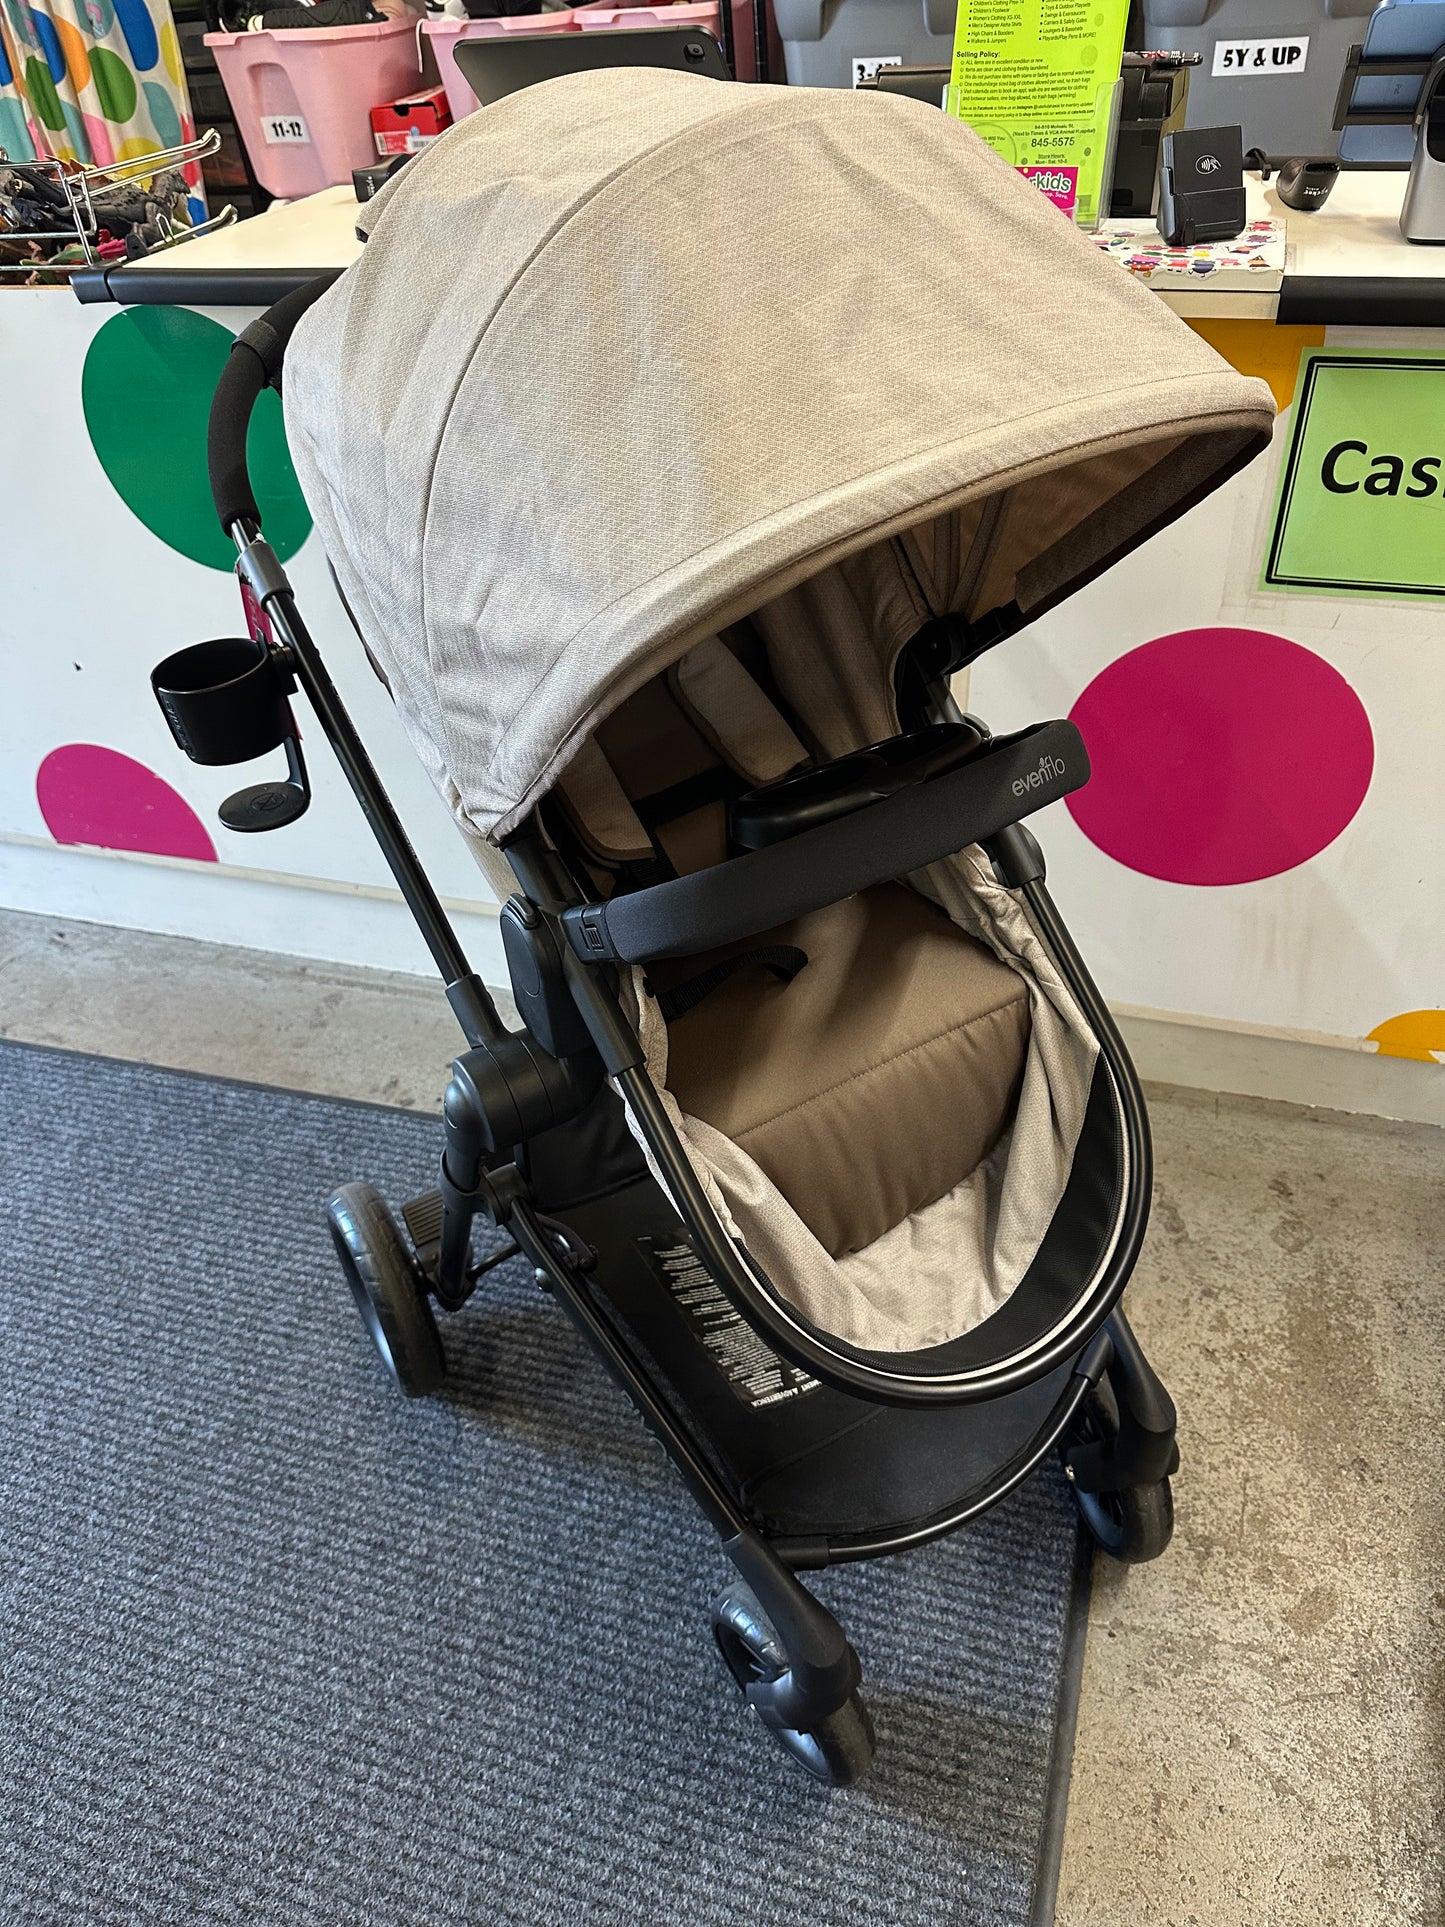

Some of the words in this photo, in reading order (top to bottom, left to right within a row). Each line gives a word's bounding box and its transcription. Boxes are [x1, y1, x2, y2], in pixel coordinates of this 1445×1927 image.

[957, 51, 979, 59] Selling
[980, 50, 1000, 58] Policy:
[1224, 48, 1250, 68] 5Y
[1254, 48, 1266, 67] &
[1272, 46, 1302, 66] UP
[272, 122, 303, 137] 11-12
[1031, 136, 1075, 148] 845-5575
[1321, 440, 1445, 499] Cas
[1012, 755, 1066, 796] evenflo
